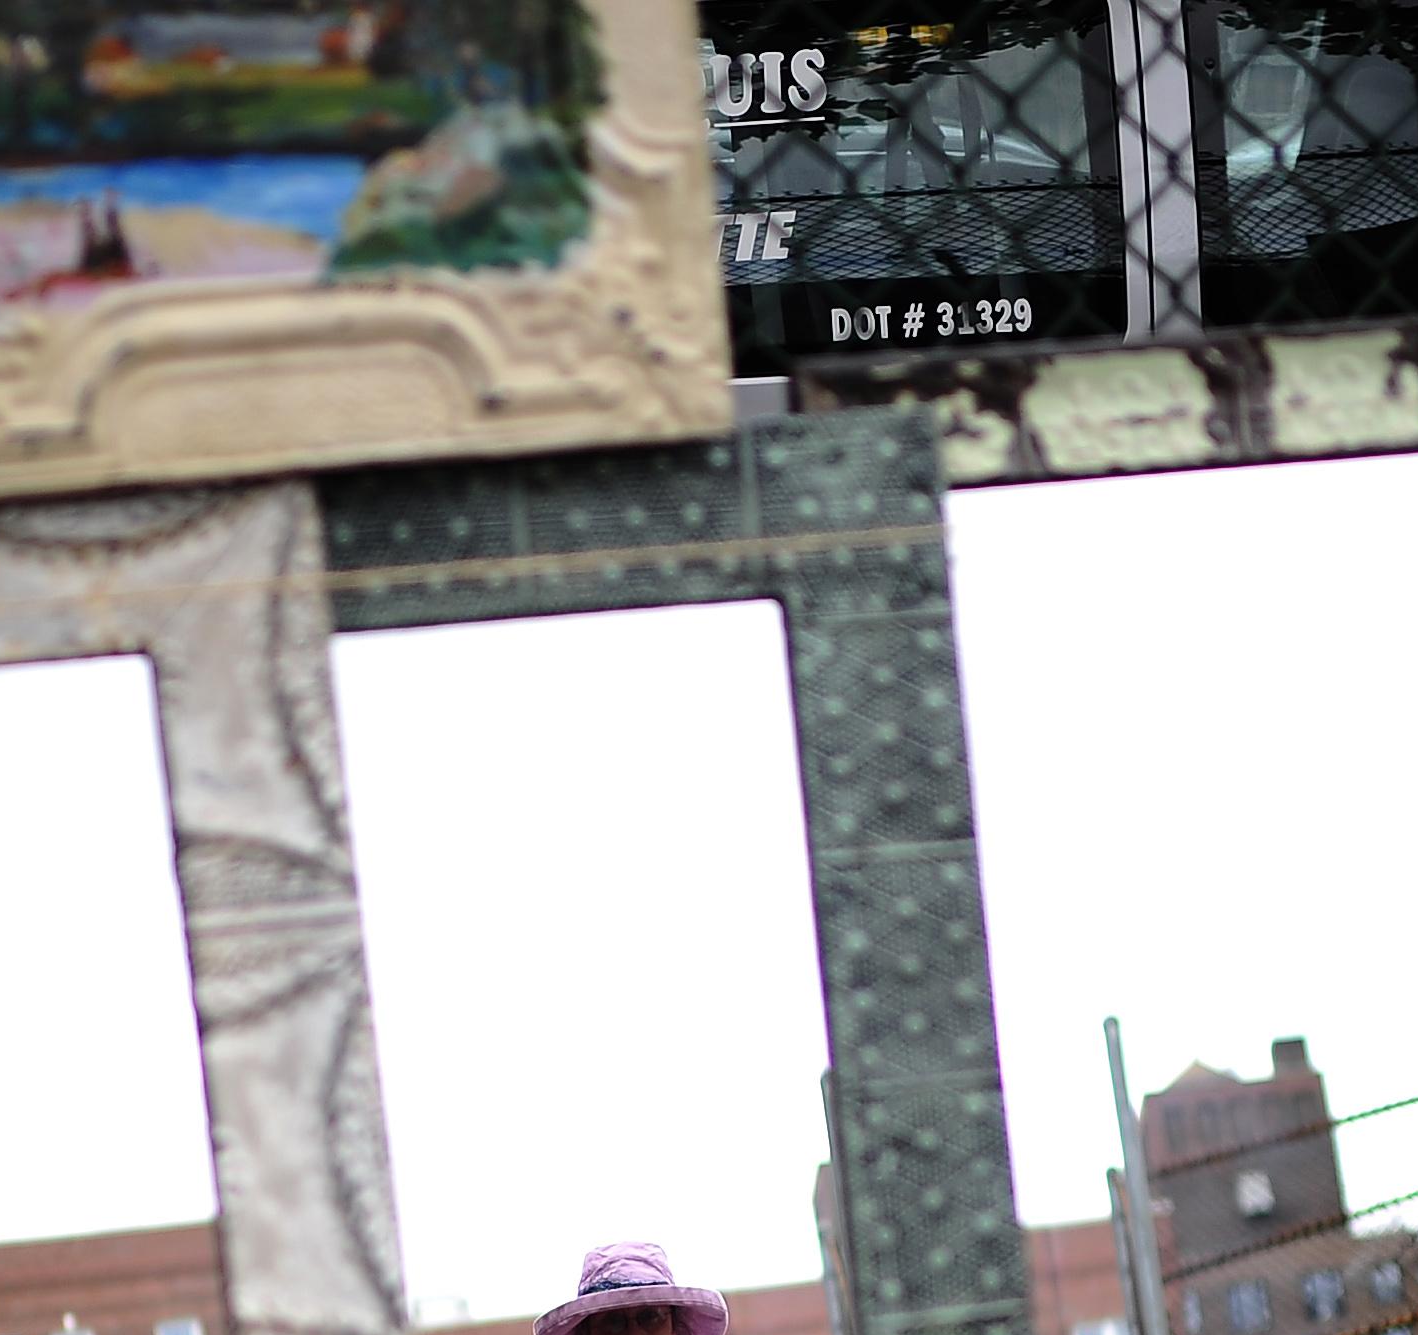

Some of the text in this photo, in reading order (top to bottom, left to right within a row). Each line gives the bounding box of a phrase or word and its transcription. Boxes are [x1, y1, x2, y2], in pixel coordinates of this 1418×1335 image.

[708, 48, 828, 118] UIS
[831, 297, 1032, 342] DOT # 31329
